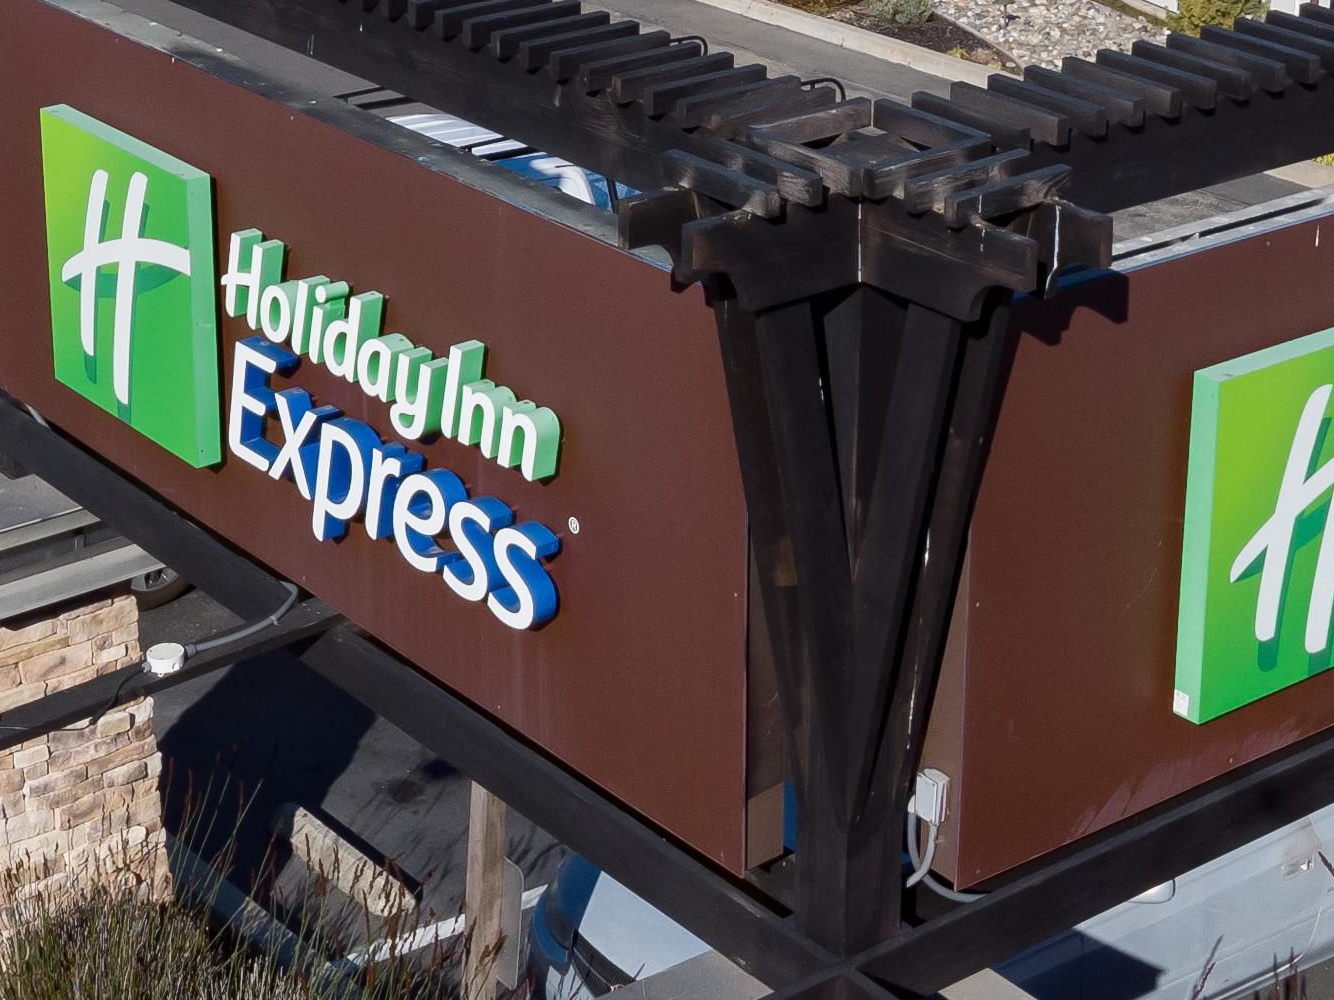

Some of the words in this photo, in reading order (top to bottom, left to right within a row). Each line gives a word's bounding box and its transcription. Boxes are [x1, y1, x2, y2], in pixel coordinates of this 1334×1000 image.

[221, 230, 440, 441] Holiday
[441, 341, 545, 482] Inn
[227, 340, 543, 631] Express
